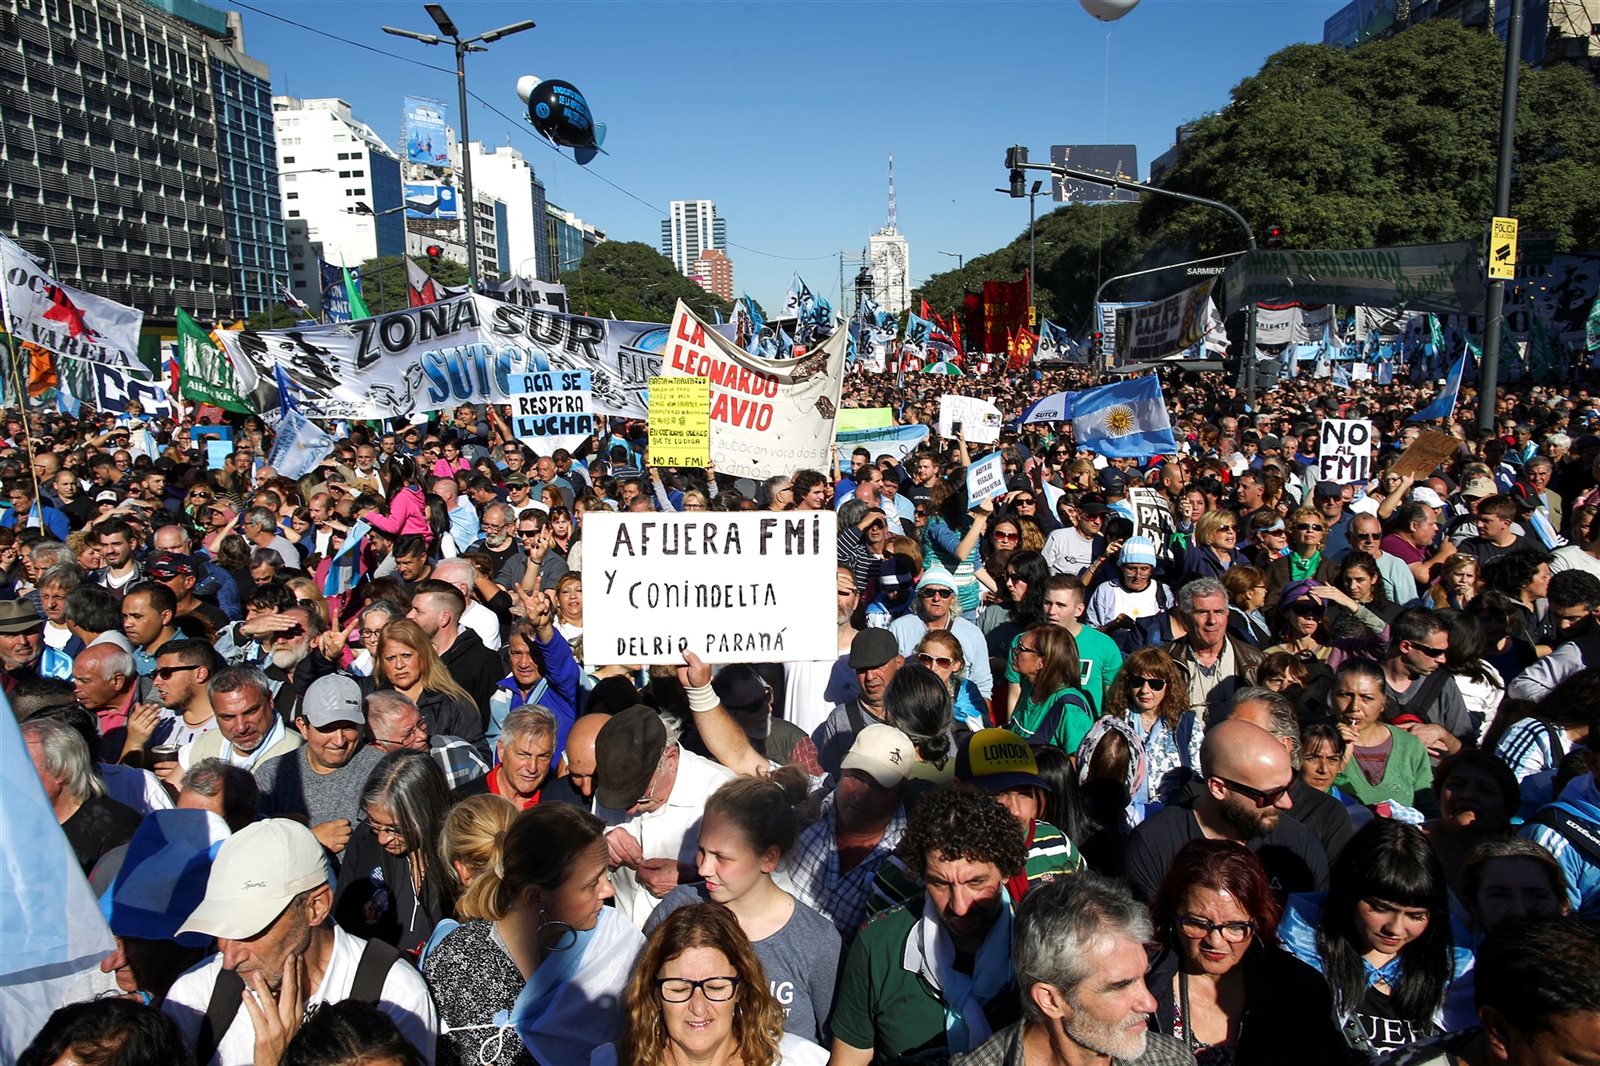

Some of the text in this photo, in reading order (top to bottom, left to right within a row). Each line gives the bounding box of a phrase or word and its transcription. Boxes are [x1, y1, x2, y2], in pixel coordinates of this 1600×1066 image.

[355, 296, 480, 369] ZONA
[493, 304, 606, 361] SUR
[676, 312, 706, 348] LA
[523, 372, 581, 393] ACA SE
[671, 345, 779, 399] LEONARDO
[710, 390, 774, 431] AVIO
[518, 415, 592, 437] LUCHA
[1323, 421, 1368, 446] NO
[653, 456, 664, 465] NO
[668, 457, 680, 466] AL
[1335, 446, 1355, 455] AL
[1320, 455, 1368, 480] FMI
[984, 743, 1029, 761] LONDON
